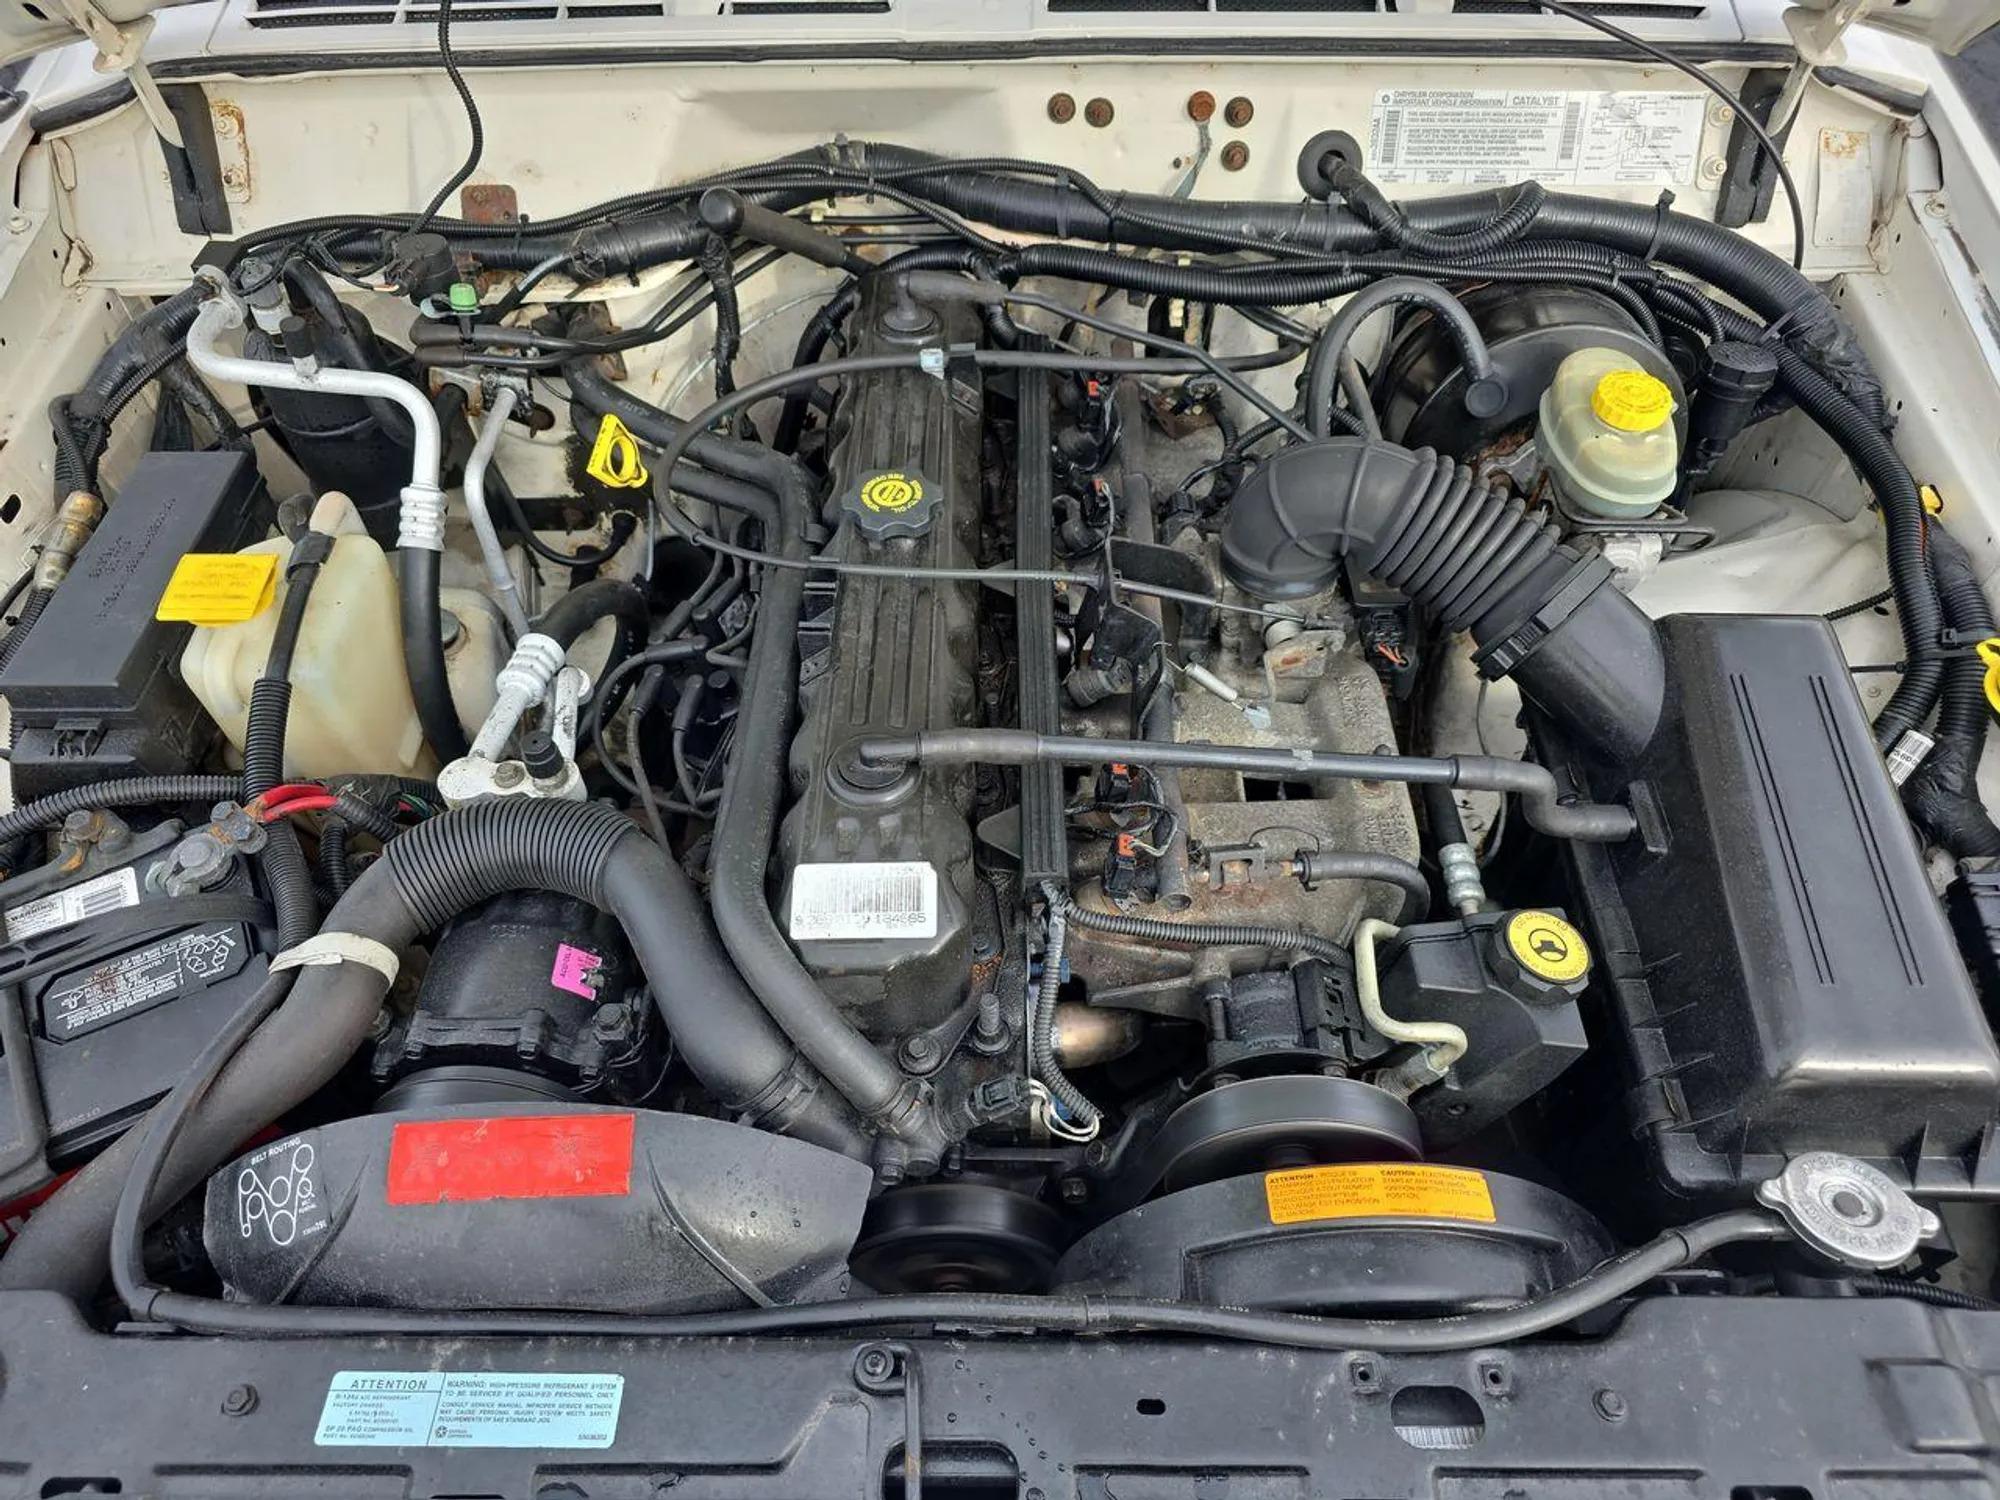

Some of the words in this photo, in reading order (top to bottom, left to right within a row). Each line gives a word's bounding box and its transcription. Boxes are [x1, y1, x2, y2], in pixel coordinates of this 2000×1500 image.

[1513, 96, 1560, 106] CATALYST
[268, 1137, 301, 1157] ROUTING
[1270, 1173, 1314, 1183] ATTENTION
[350, 1379, 428, 1390] ATTENTION
